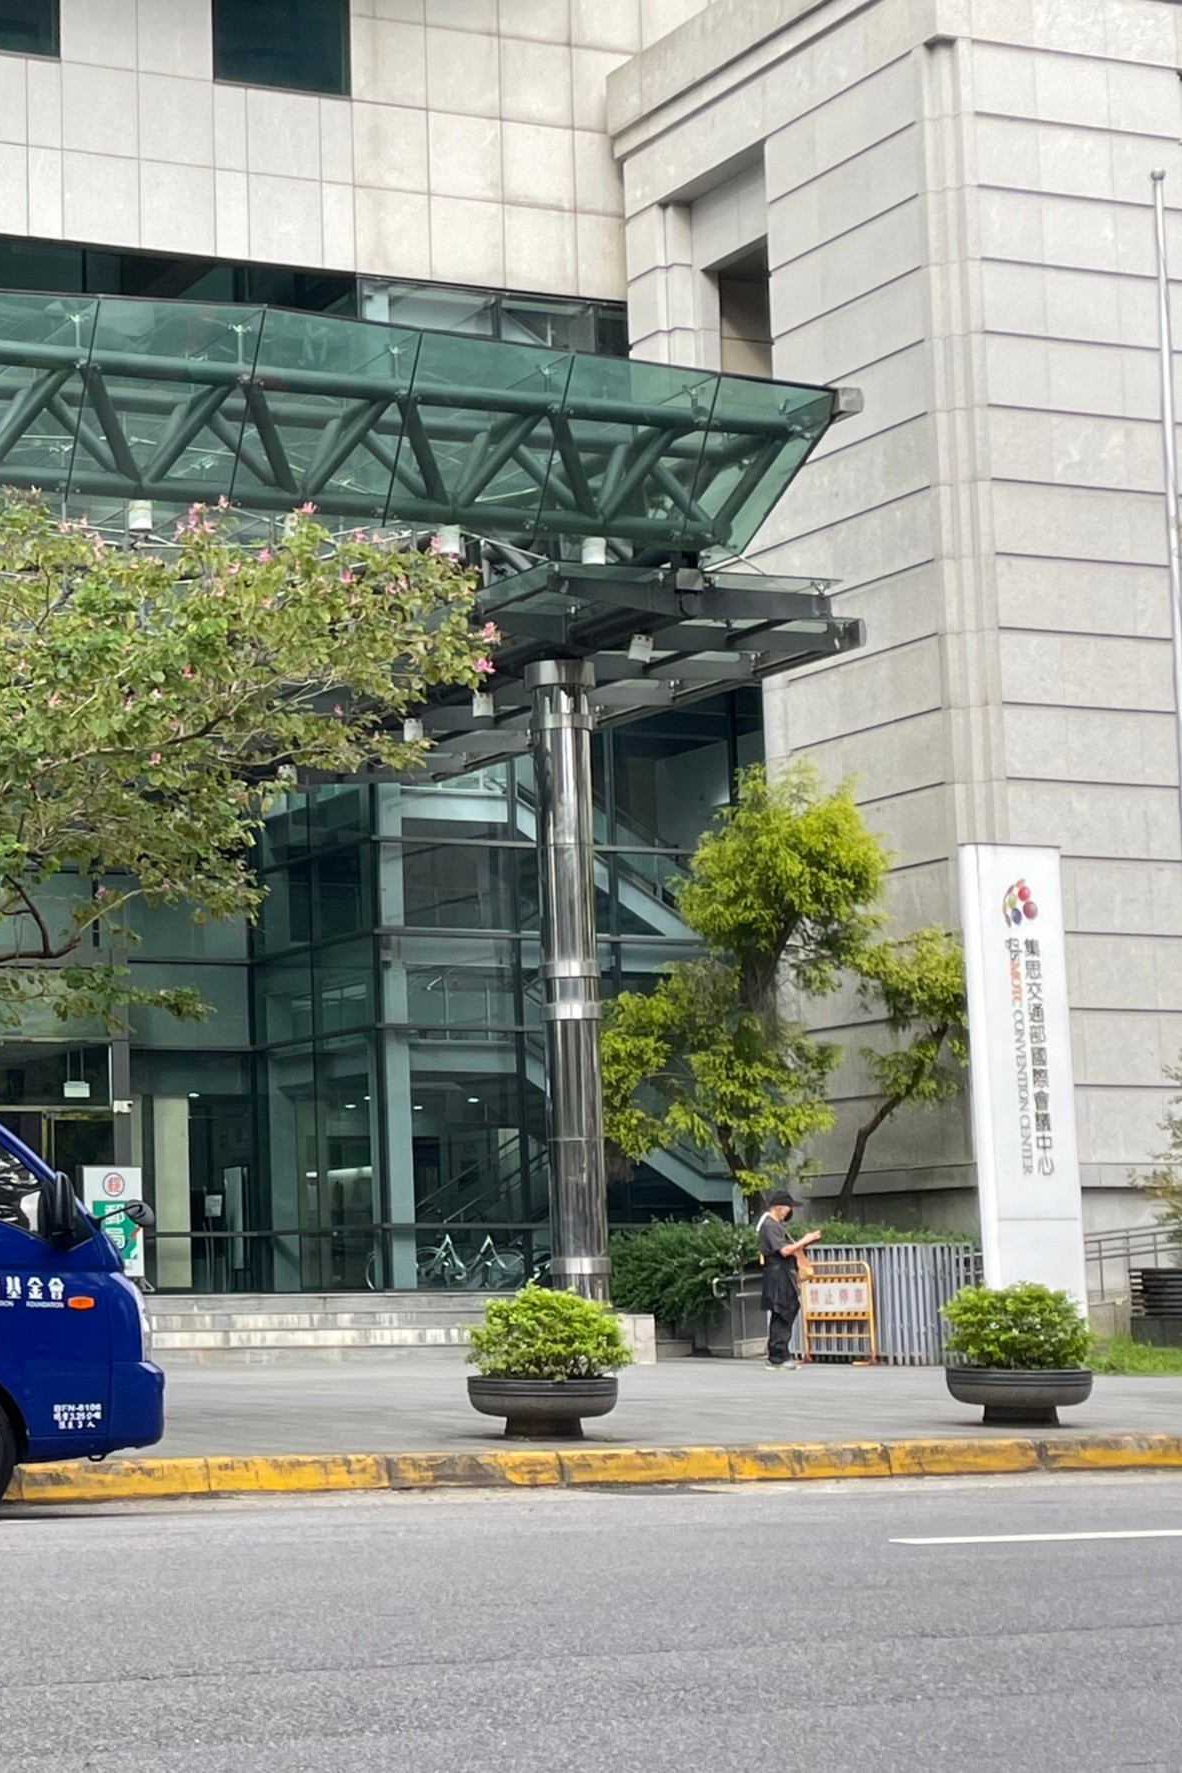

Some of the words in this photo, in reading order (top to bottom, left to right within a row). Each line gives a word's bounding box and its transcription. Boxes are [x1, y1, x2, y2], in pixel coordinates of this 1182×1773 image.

[1012, 1010, 1030, 1112] CONVENTION
[1024, 938, 1054, 1176] 集思交通部國際會議中心
[1020, 1115, 1034, 1175] CENTER
